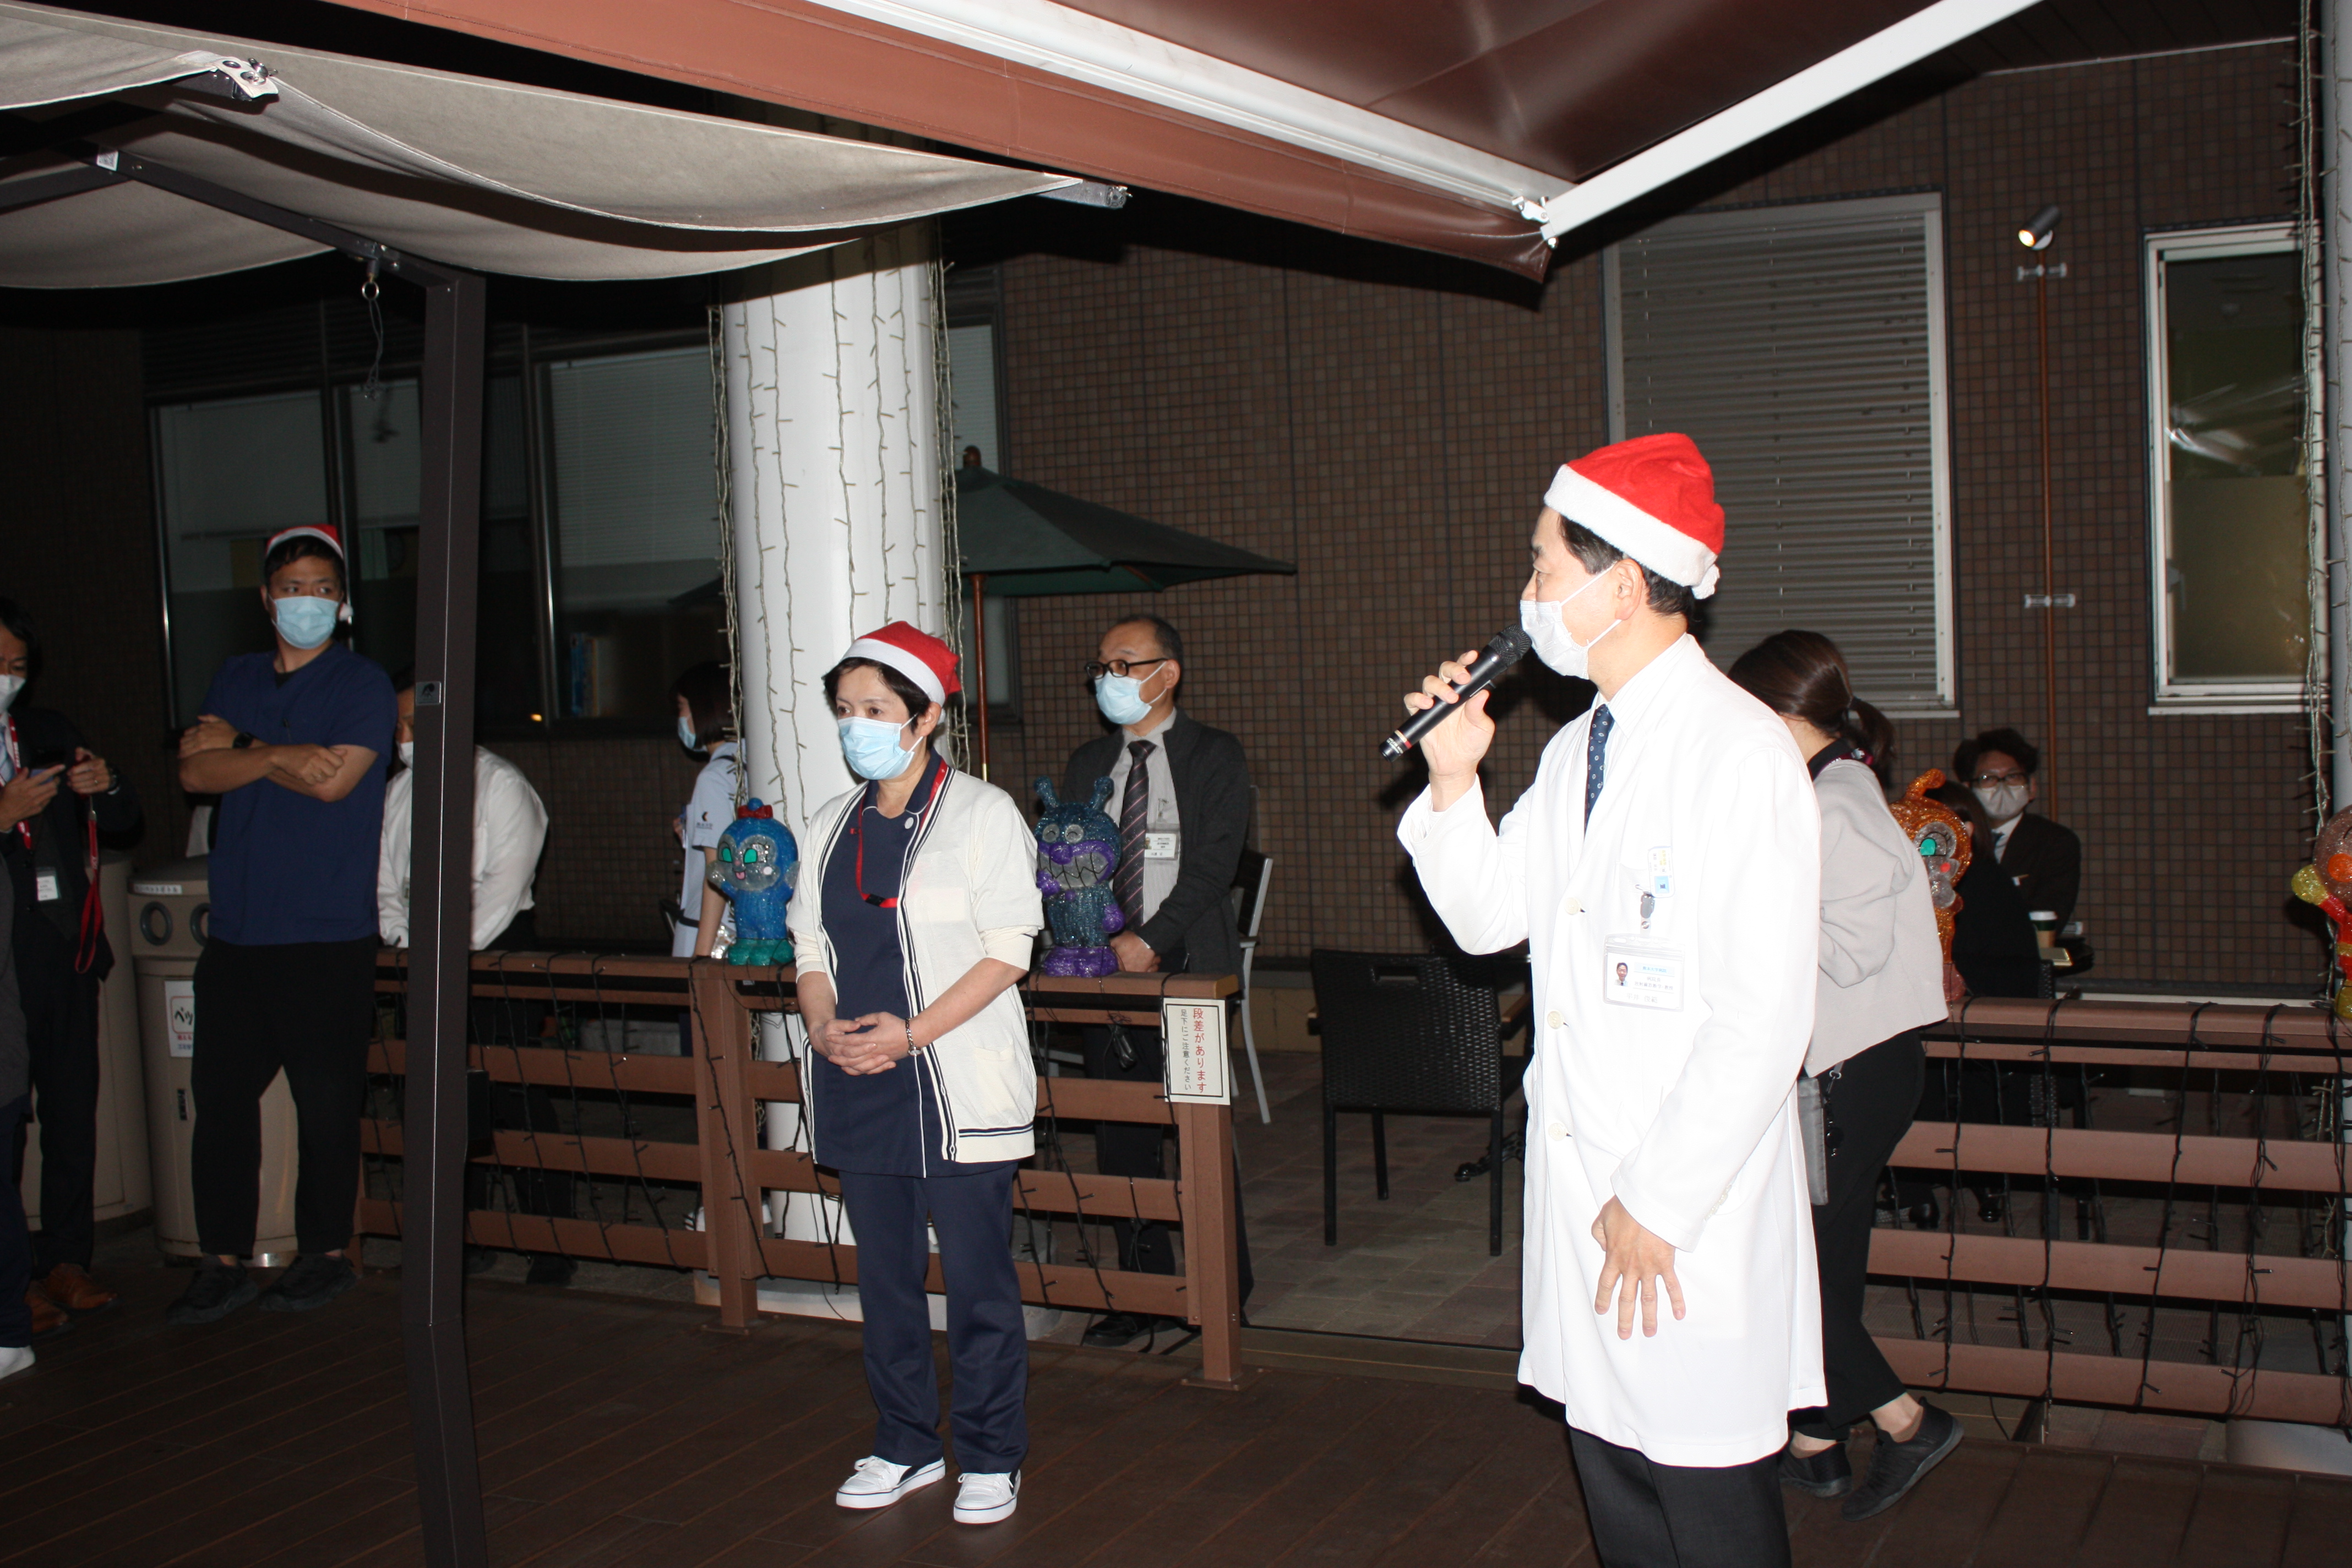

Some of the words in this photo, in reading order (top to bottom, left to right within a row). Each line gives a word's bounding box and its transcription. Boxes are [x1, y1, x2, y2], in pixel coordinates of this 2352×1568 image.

[1180, 1009, 1191, 1090] 足下にご注意ください
[1193, 1008, 1207, 1093] 段差があります
